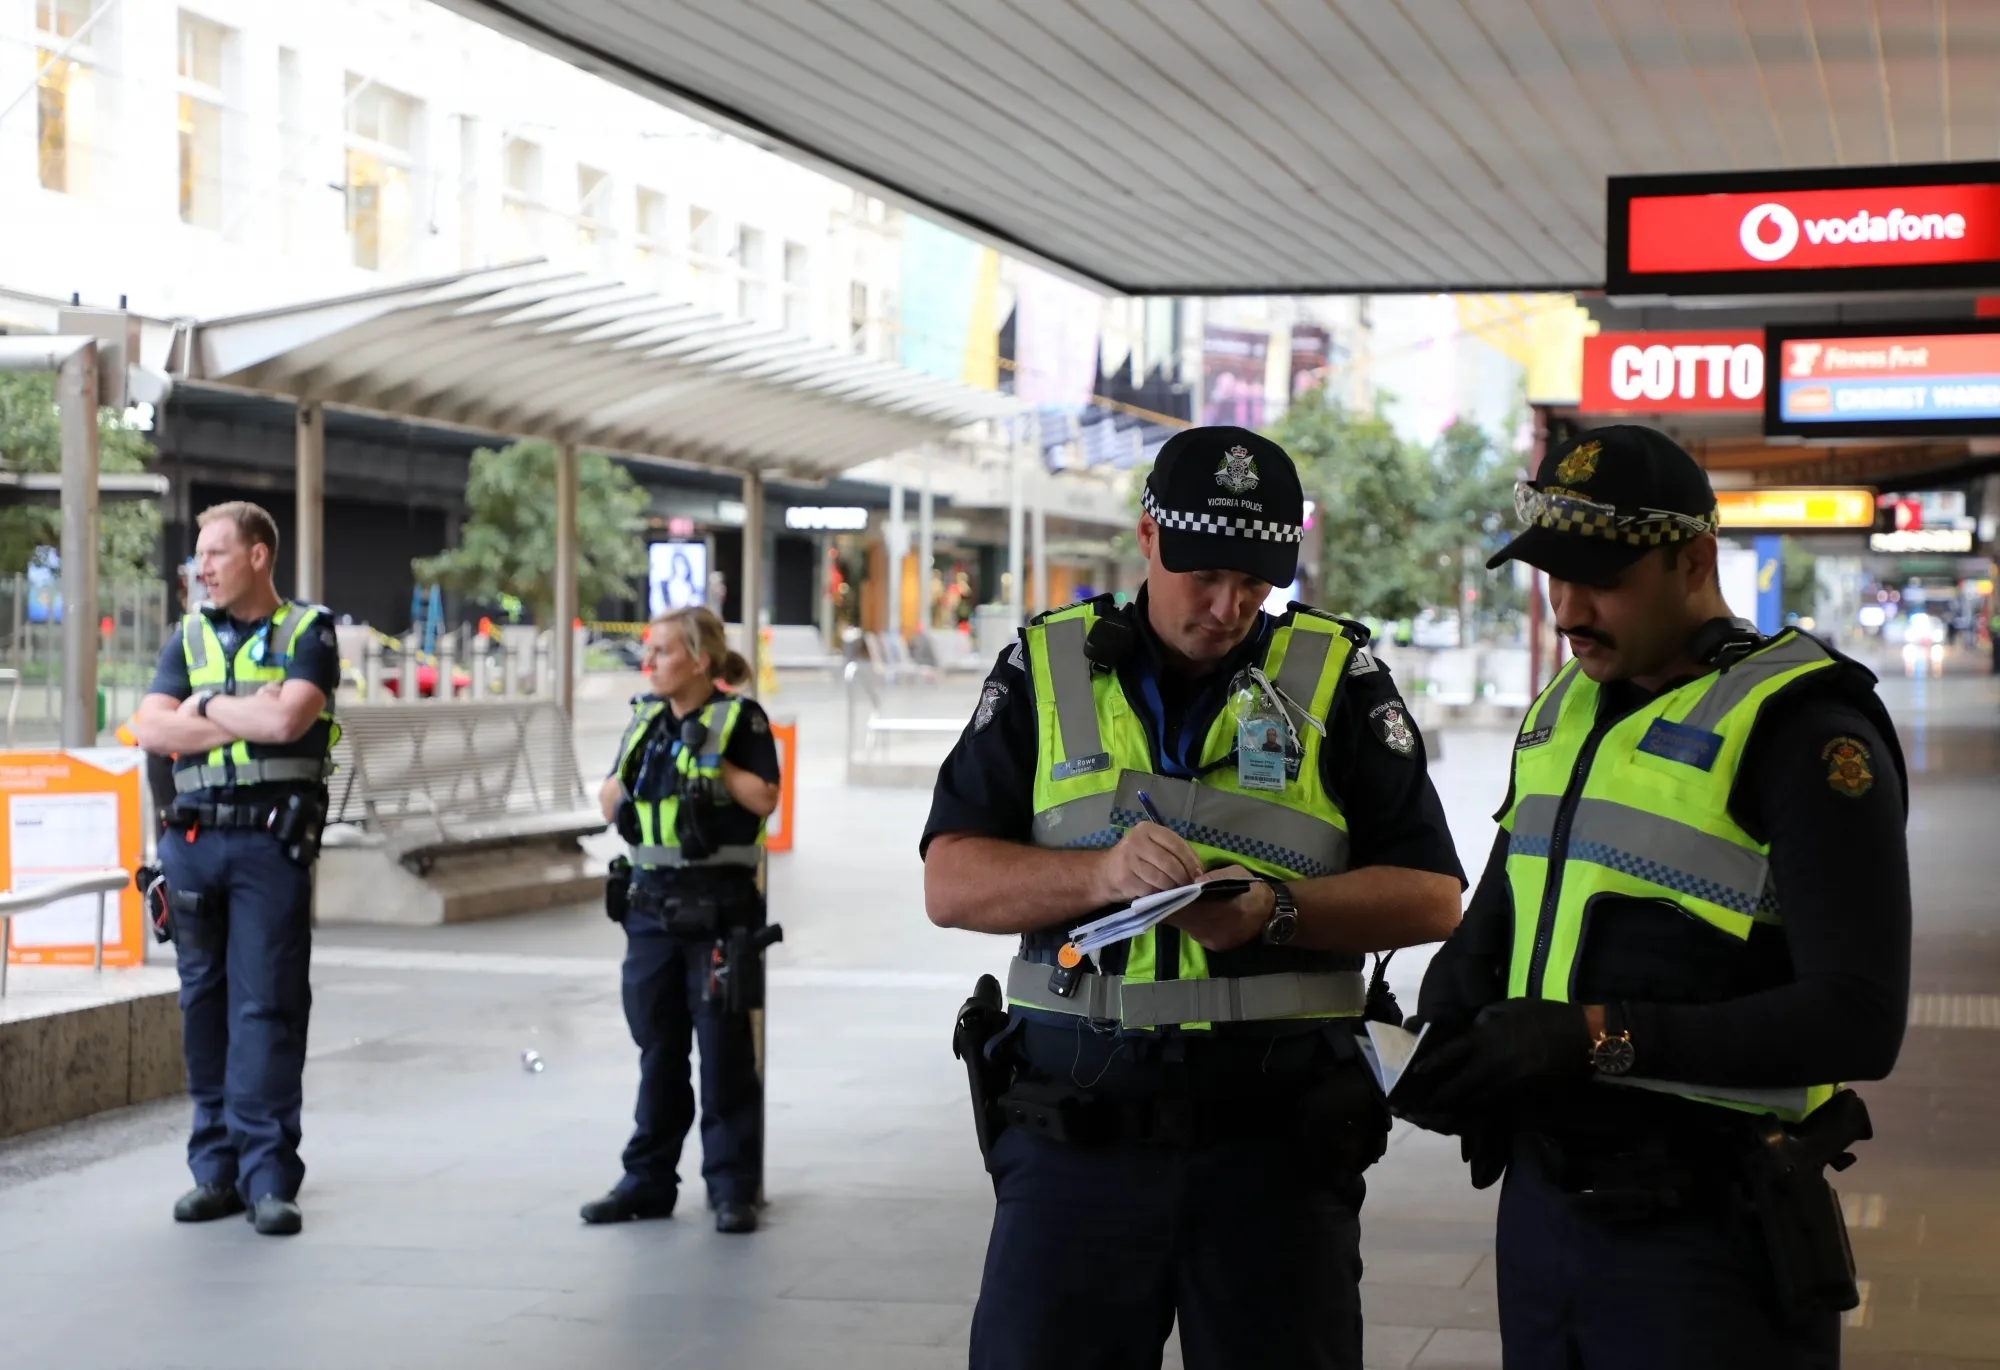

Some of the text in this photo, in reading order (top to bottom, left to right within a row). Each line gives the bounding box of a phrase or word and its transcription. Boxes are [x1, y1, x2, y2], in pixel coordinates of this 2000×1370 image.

[1803, 208, 1966, 244] vodafone
[1611, 344, 1764, 400] COTTO
[1207, 497, 1263, 512] VICTORIA POLICE
[1369, 700, 1404, 719] VICTORIA POLICE
[1077, 757, 1096, 767] Rowe
